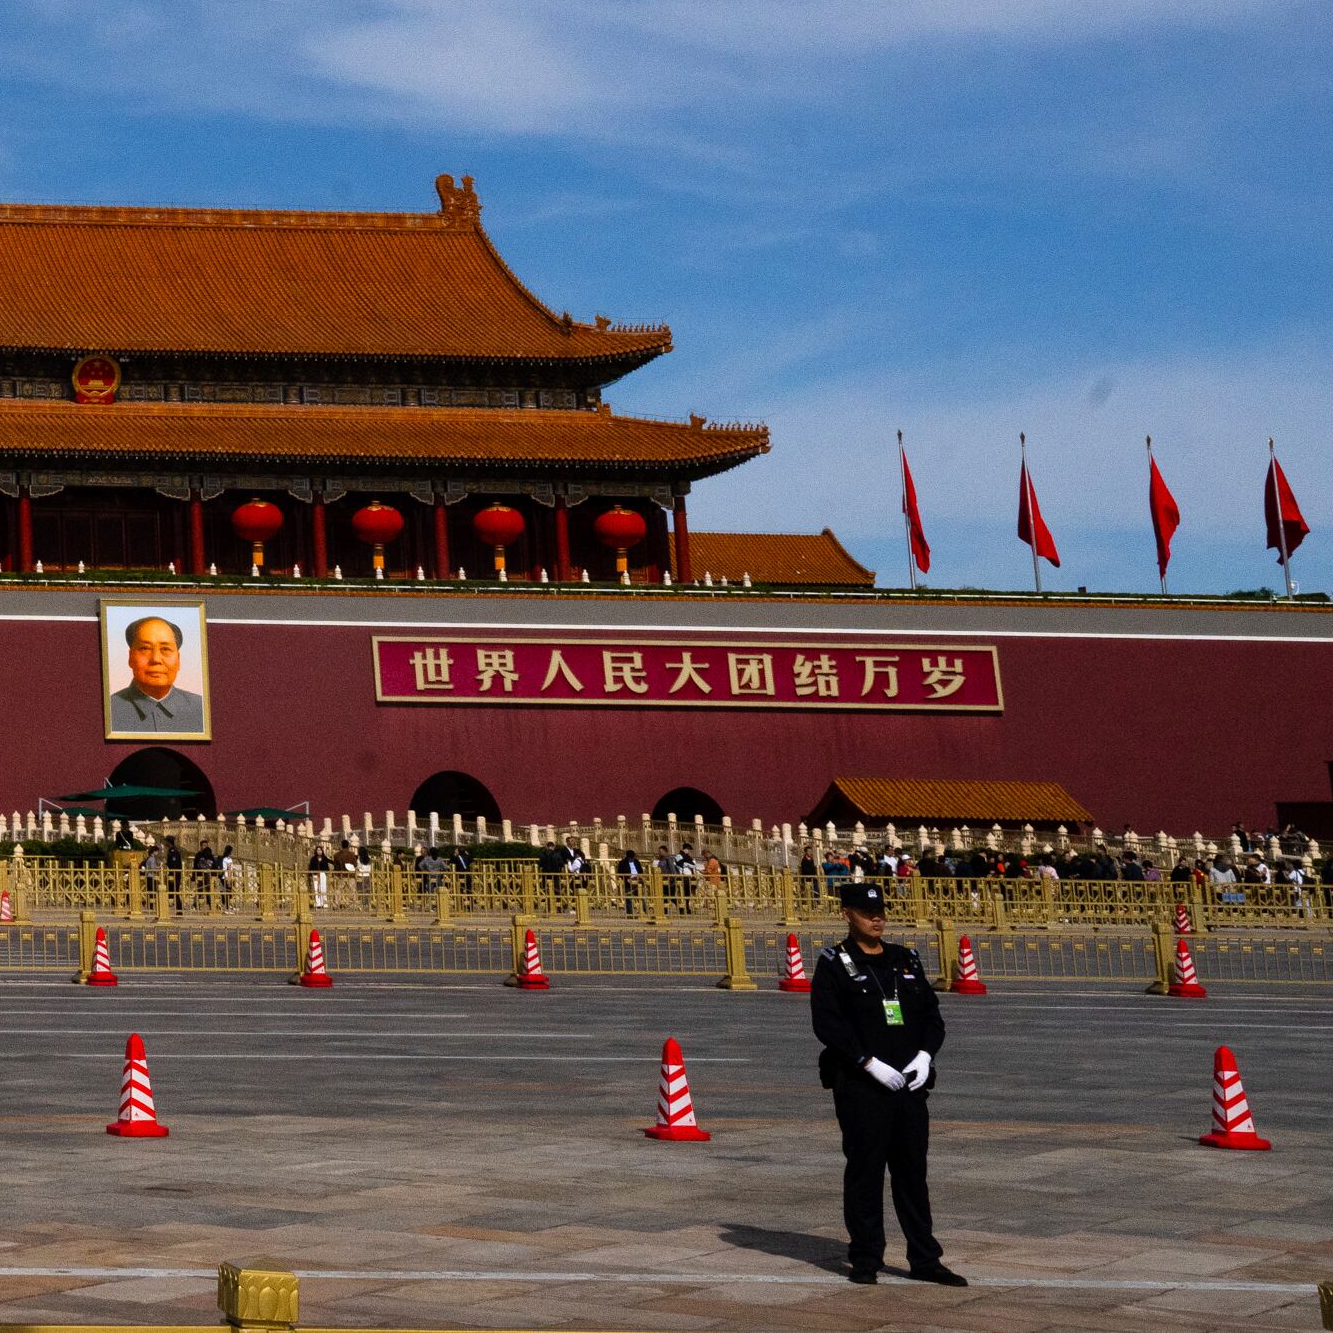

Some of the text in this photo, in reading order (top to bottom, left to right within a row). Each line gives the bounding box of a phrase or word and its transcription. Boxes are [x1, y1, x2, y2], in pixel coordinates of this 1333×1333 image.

[409, 648, 966, 698] 世界人民大团结万岁
